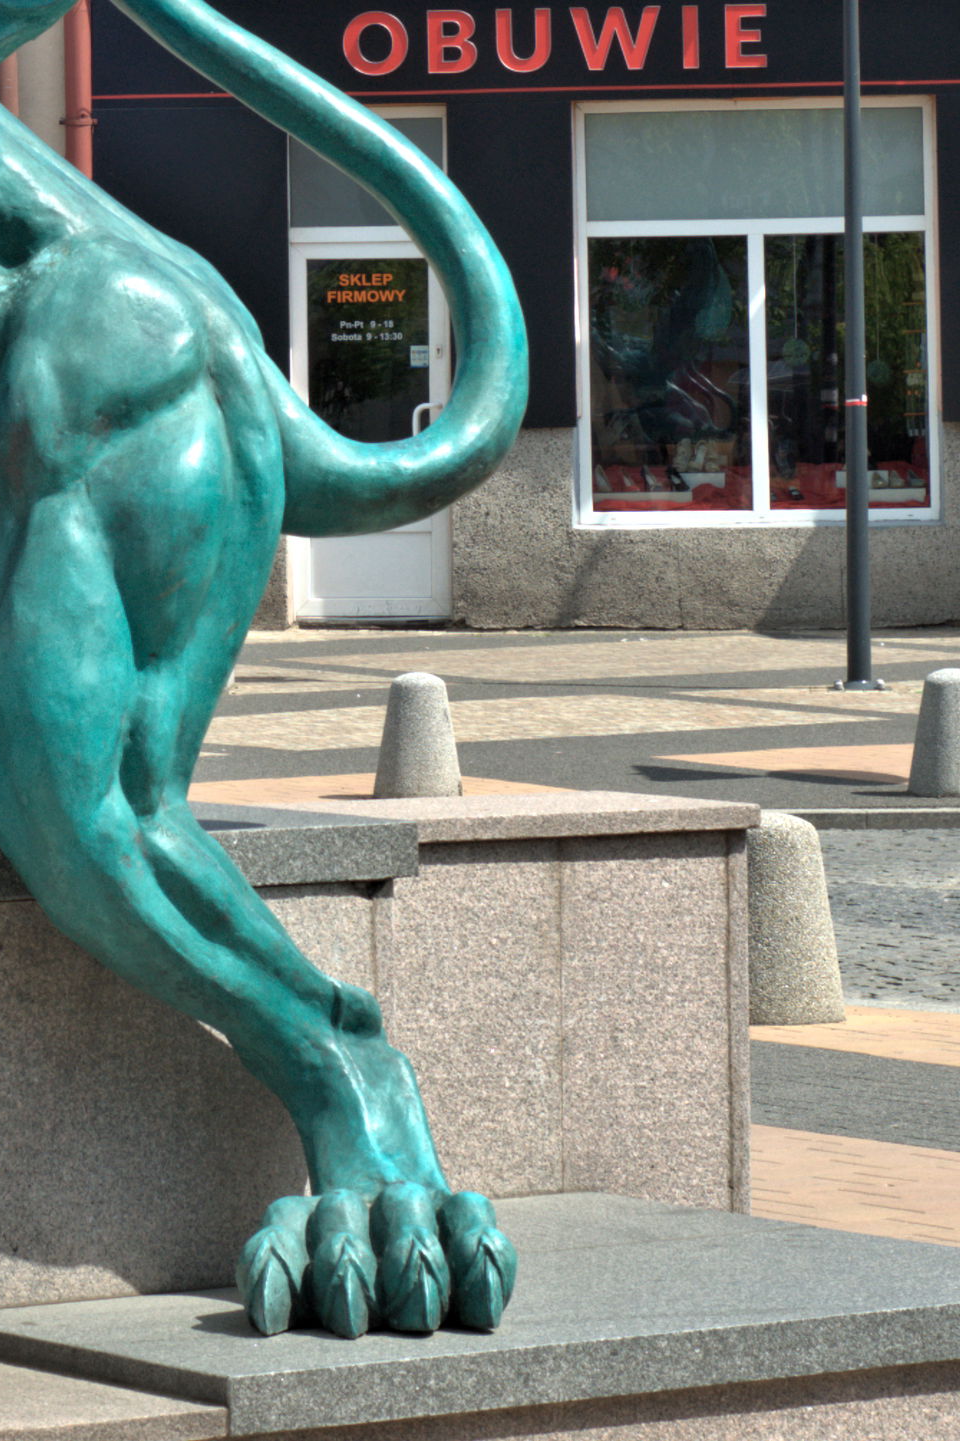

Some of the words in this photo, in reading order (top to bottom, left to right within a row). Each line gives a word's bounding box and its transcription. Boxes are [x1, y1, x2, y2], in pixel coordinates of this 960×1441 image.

[342, 4, 769, 76] OBUWIE
[339, 273, 393, 286] SKLEP
[327, 290, 406, 303] FIRMOWY
[331, 333, 362, 341] Sobota
